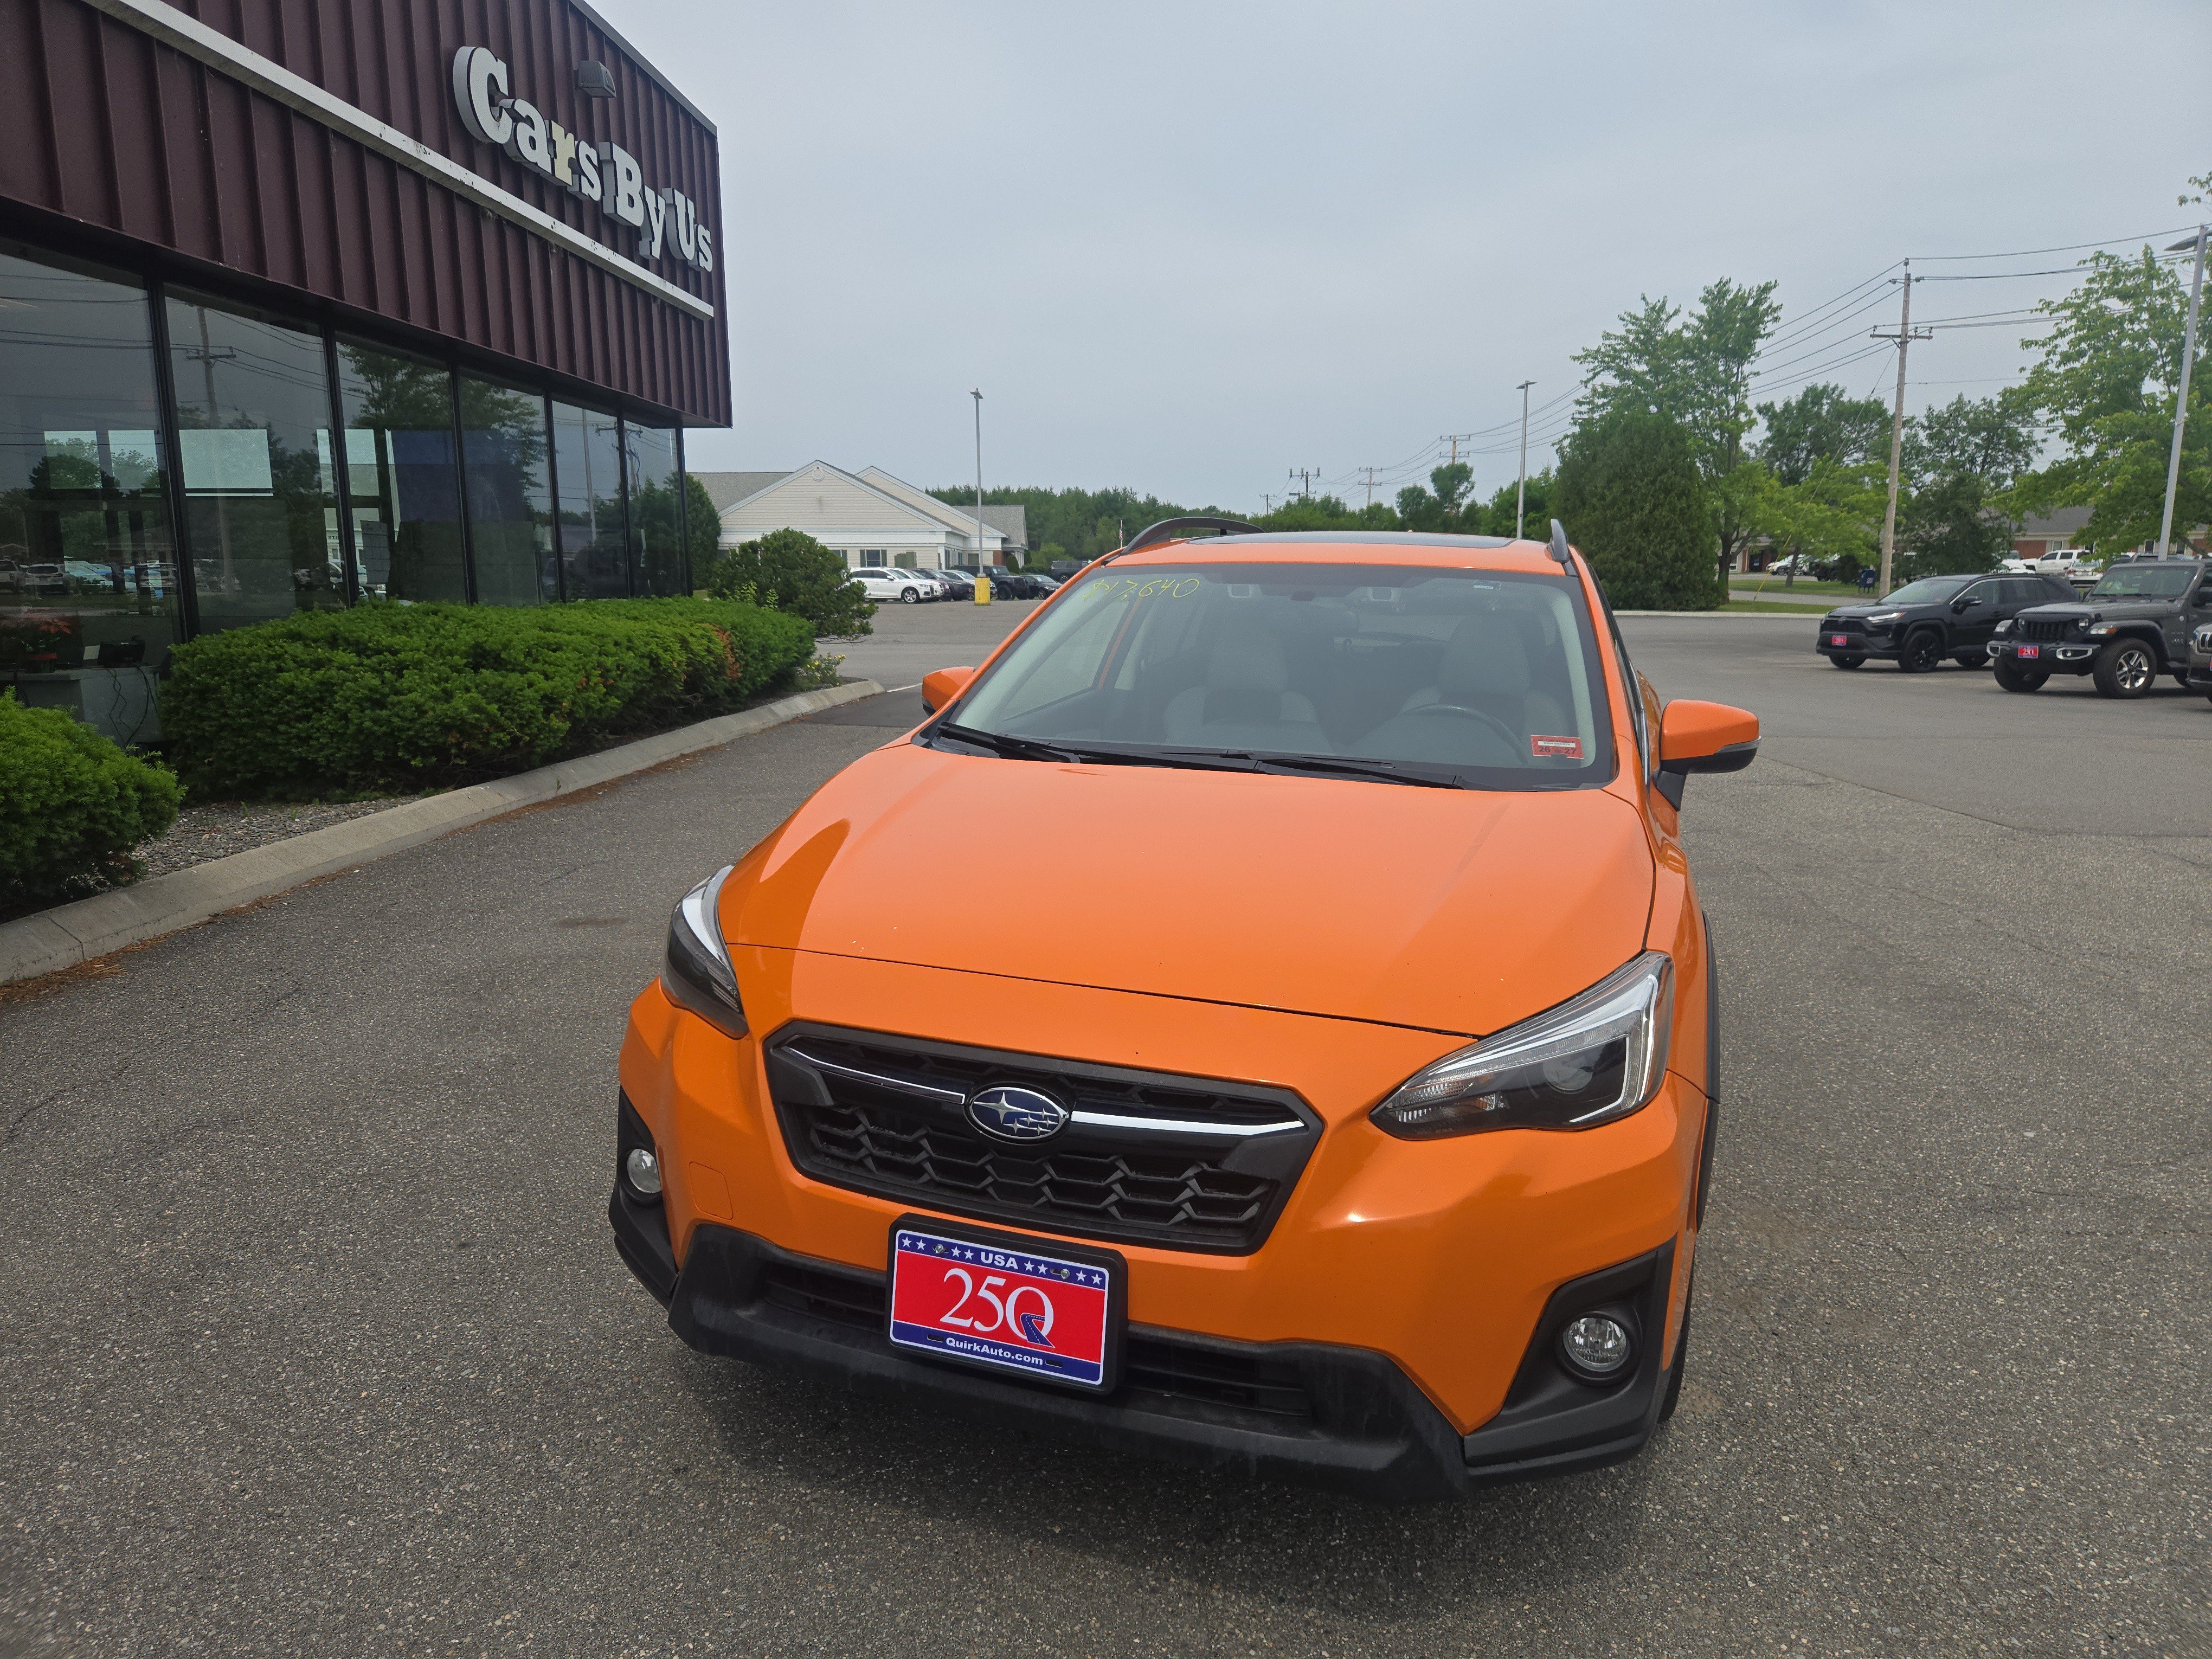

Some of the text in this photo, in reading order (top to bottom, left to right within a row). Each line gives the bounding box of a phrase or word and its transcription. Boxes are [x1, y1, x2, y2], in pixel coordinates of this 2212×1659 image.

[454, 46, 713, 272] Cars By Us
[980, 1251, 1019, 1269] USA
[946, 1337, 1043, 1365] QuirkAuto.com
